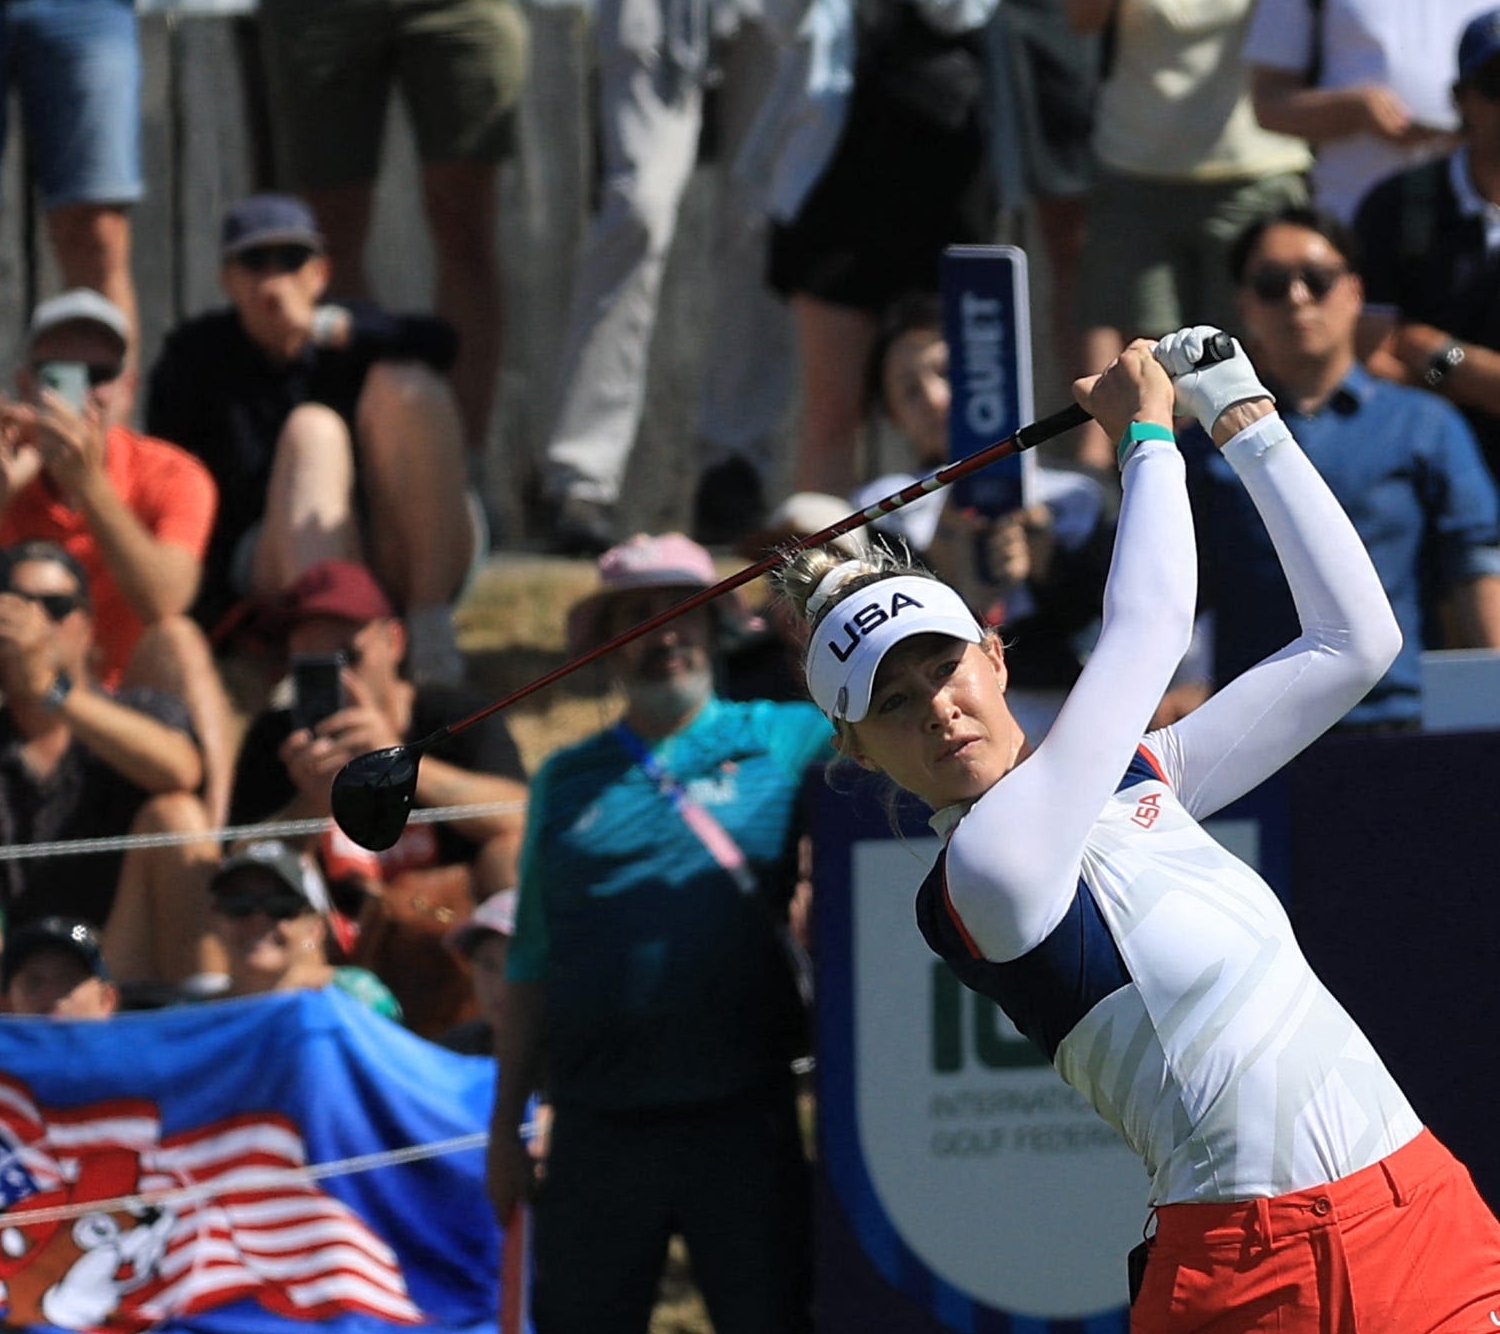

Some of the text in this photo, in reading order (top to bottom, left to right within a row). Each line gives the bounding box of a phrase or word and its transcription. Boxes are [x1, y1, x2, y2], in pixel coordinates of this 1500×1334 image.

[959, 291, 1005, 436] QUIET
[827, 591, 925, 664] USA
[930, 1126, 1003, 1158] GOLF
